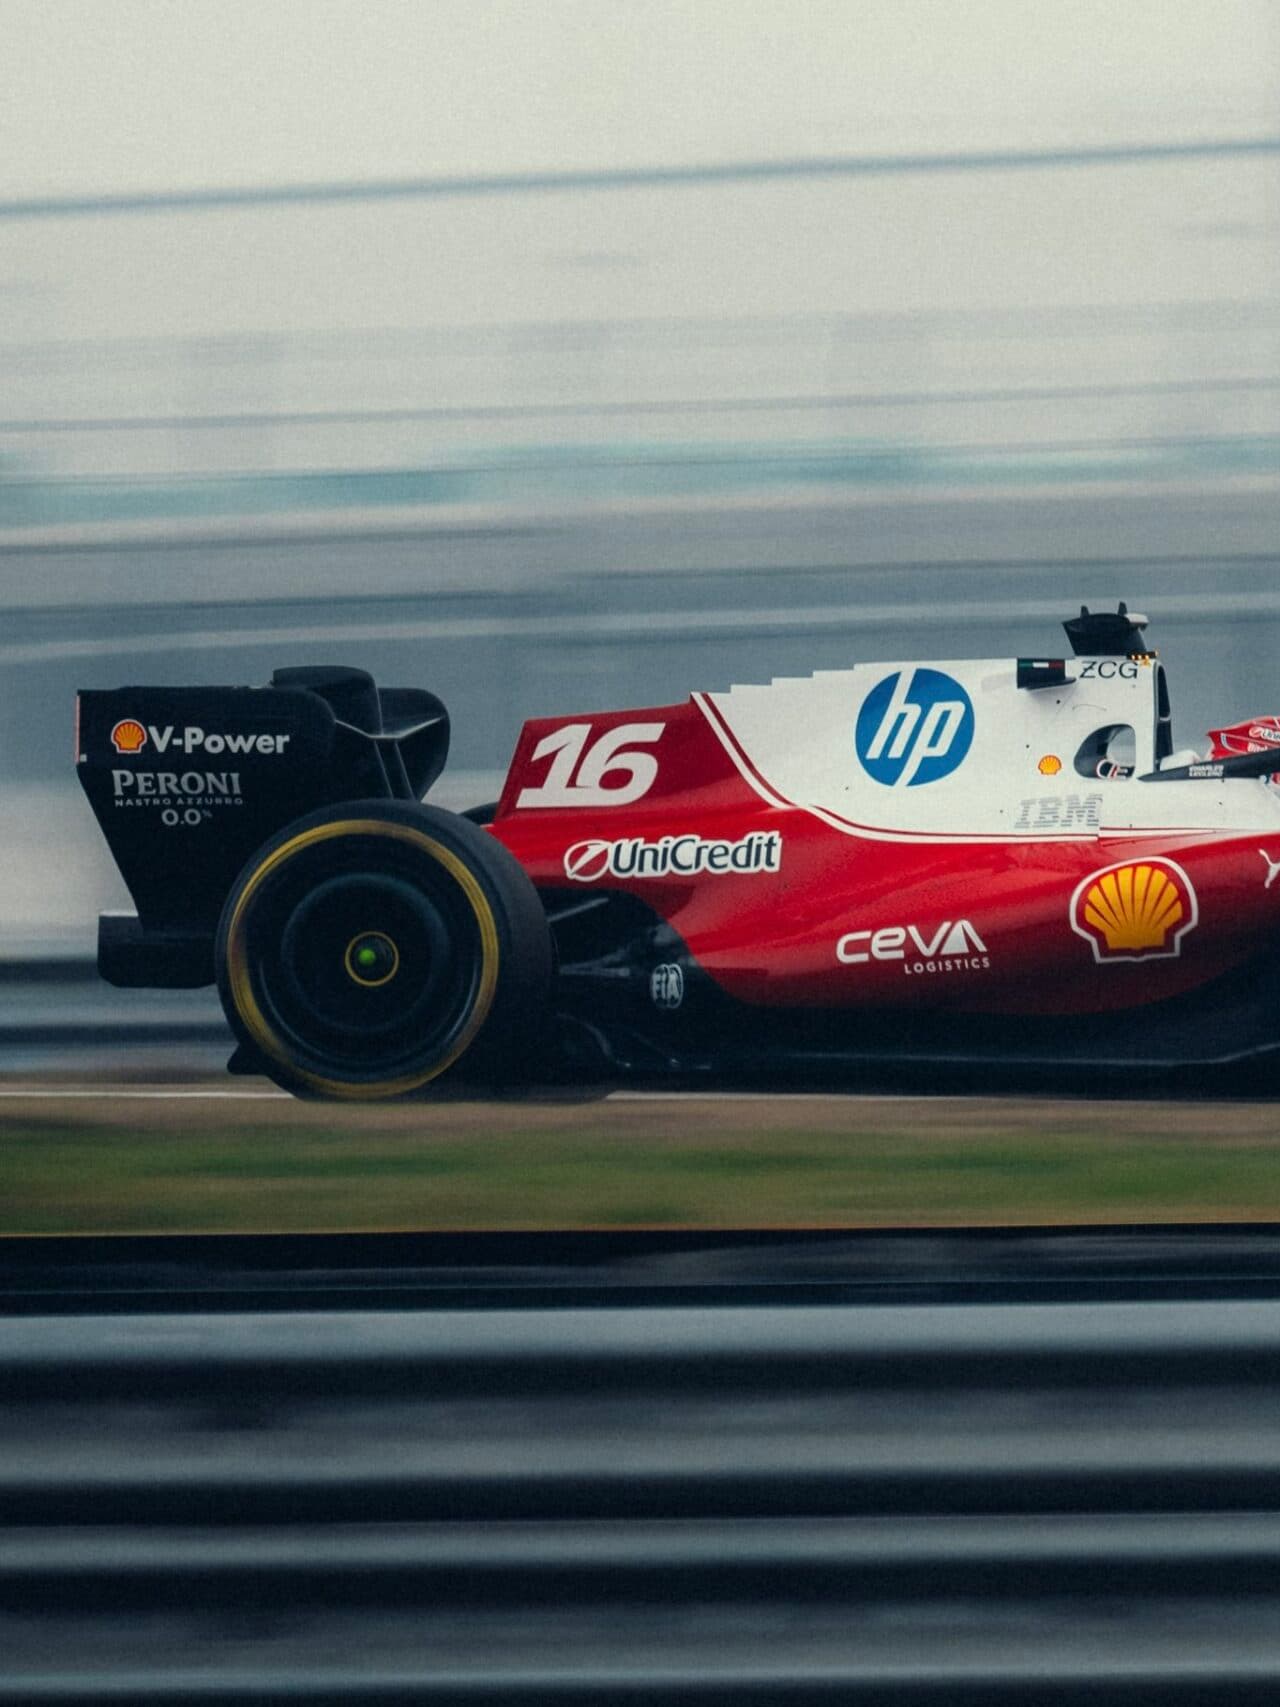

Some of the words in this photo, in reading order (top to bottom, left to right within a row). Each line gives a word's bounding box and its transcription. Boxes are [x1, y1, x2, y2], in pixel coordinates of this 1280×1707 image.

[1079, 660, 1138, 679] ZCG
[148, 726, 290, 754] V-Power
[865, 668, 966, 787] hp
[516, 722, 666, 808] 16
[112, 770, 242, 796] PERONI
[115, 798, 171, 808] NASTRO
[176, 797, 243, 806] AZZURRO
[1013, 793, 1103, 828] IBM
[611, 833, 779, 875] UniCredit
[904, 957, 991, 975] LOGISTICS
[652, 969, 682, 1001] FIA
